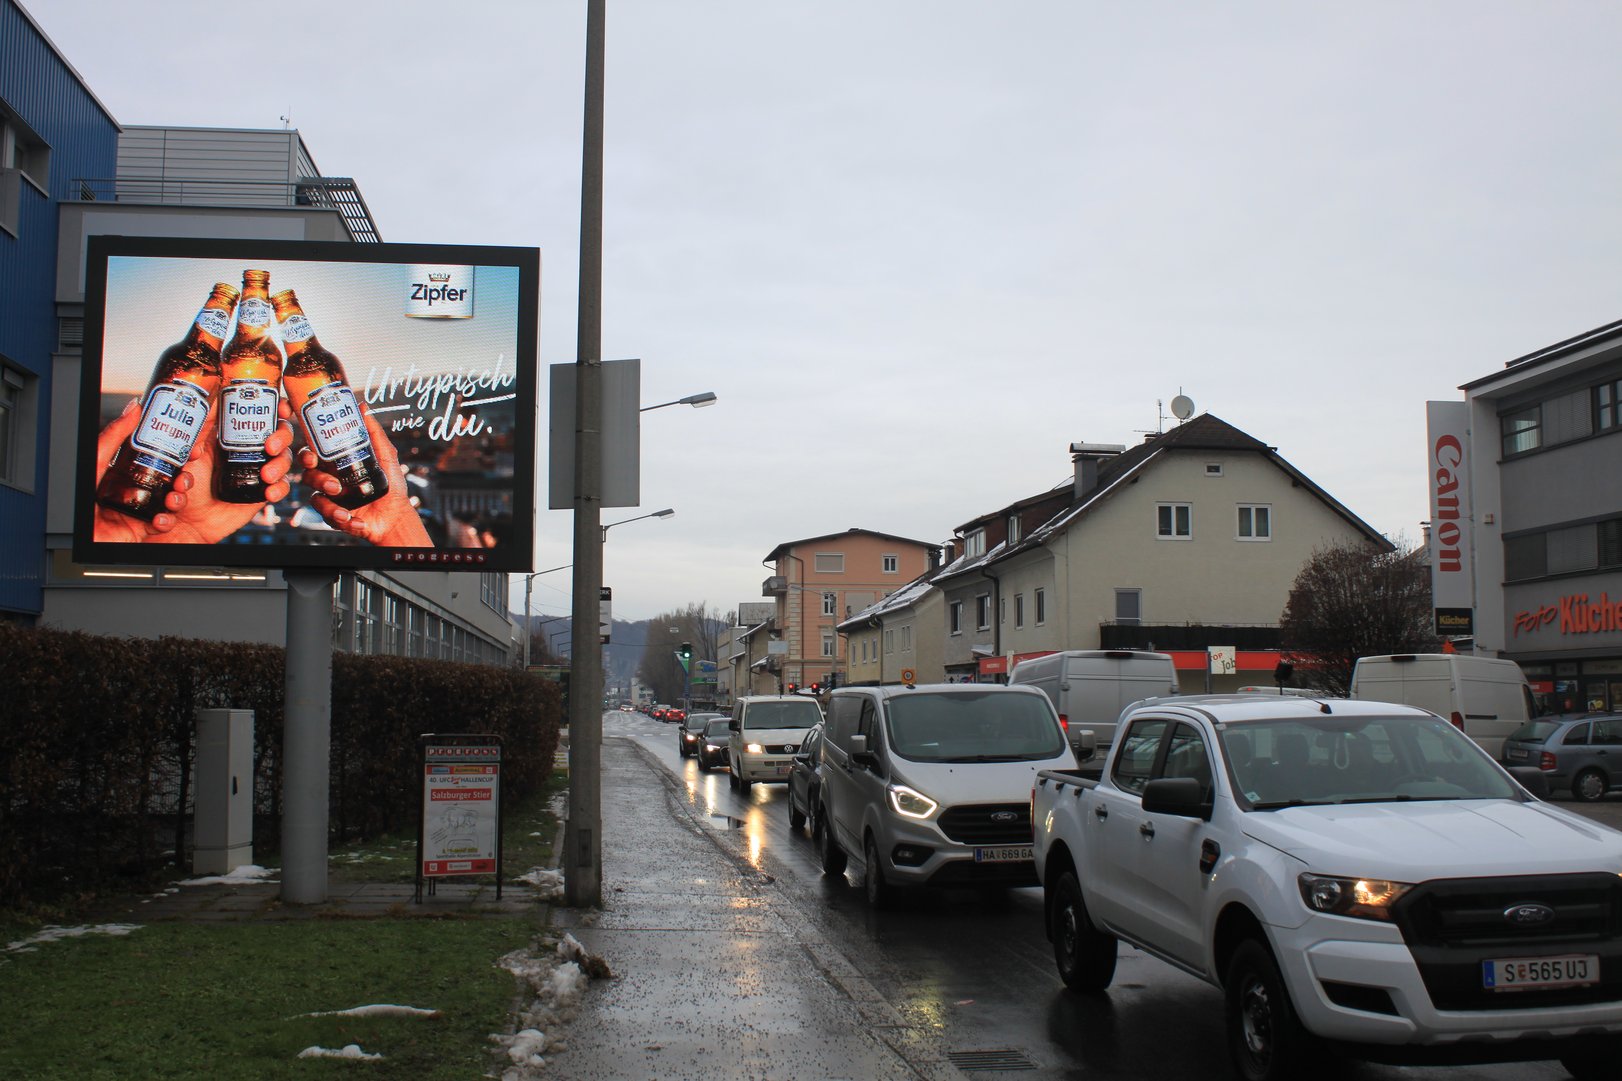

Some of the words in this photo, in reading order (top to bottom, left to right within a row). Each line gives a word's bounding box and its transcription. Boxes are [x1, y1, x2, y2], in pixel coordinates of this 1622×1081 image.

[410, 283, 468, 306] Zipfer
[363, 353, 516, 410] Urtypisch
[160, 402, 195, 427] Julia
[228, 402, 270, 416] Florian
[316, 404, 354, 427] Sarah
[230, 417, 266, 432] Urtyp
[391, 413, 425, 433] wie
[1435, 434, 1463, 573] Canon
[394, 553, 484, 561] progress
[1513, 604, 1558, 639] Foto
[1221, 657, 1236, 674] Job
[431, 791, 472, 800] Salzburger
[473, 790, 491, 799] Stier
[982, 849, 995, 860] HA
[1001, 849, 1020, 860] 669
[1021, 848, 1034, 858] GA
[1504, 963, 1516, 982] S
[1528, 961, 1563, 981] 565
[1565, 959, 1588, 980] UJ
